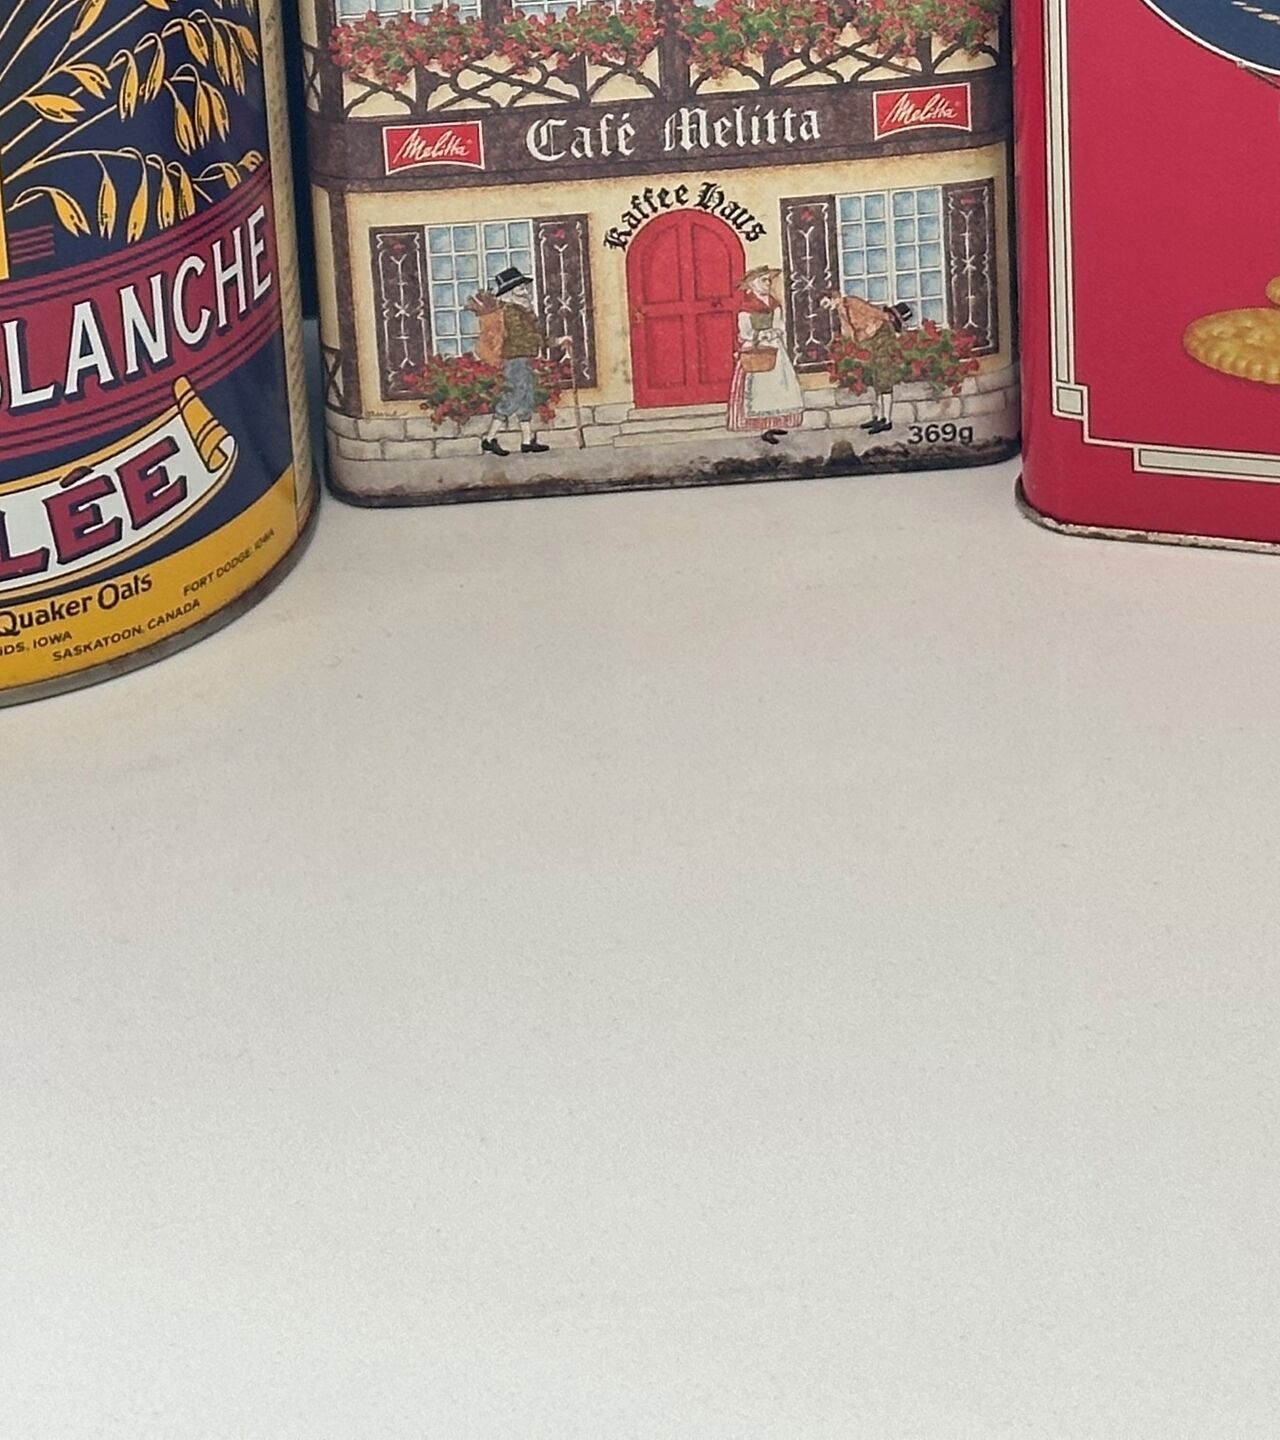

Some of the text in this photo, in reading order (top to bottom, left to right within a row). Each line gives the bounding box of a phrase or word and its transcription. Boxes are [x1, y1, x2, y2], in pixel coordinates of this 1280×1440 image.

[881, 92, 958, 129] Melitta
[393, 128, 470, 164] Melitta
[526, 103, 823, 163] Café Melitta
[603, 181, 767, 252] Kaffee Haus
[907, 422, 974, 449] 369g
[97, 572, 153, 611] Oats
[183, 571, 214, 596] FORT
[147, 599, 201, 631] CANADA
[33, 631, 73, 649] IOWA
